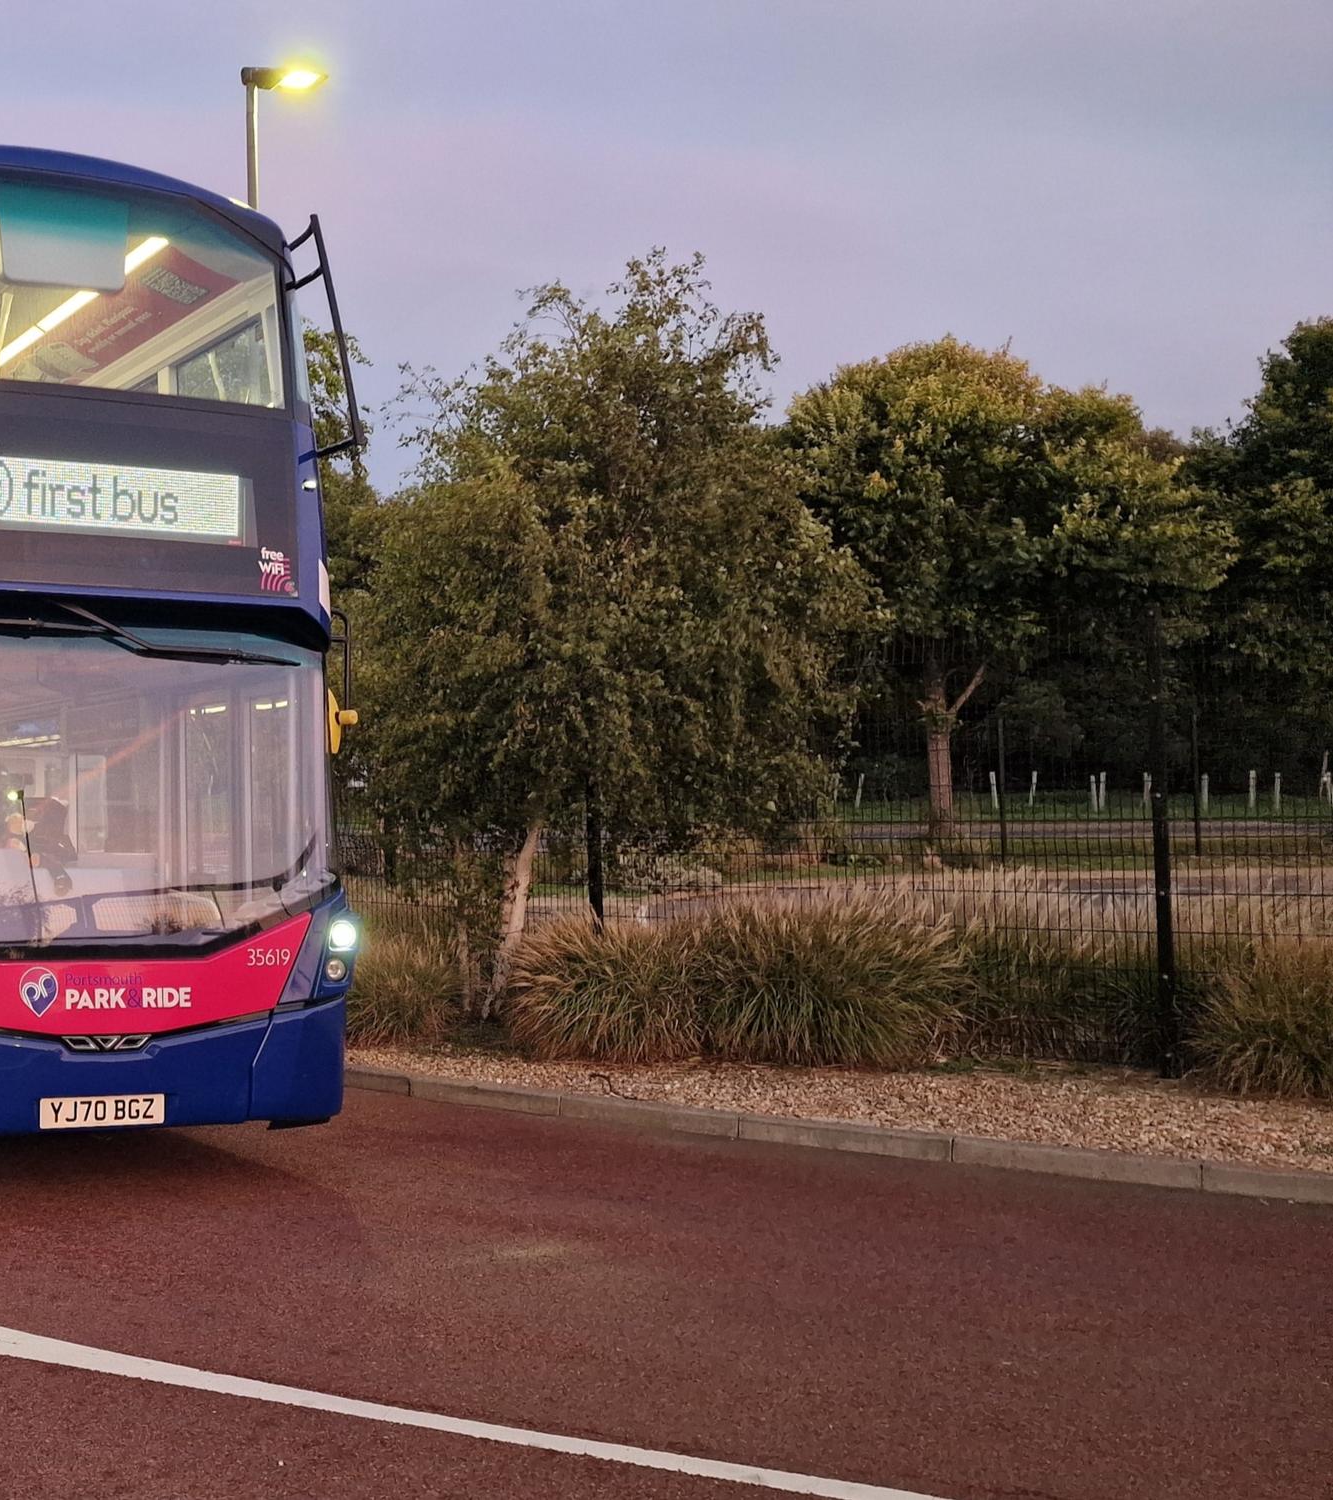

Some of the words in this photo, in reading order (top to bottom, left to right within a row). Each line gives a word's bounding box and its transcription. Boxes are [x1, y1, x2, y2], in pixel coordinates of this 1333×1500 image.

[23, 470, 101, 520] first
[110, 475, 179, 525] bus
[261, 547, 284, 561] free
[258, 561, 285, 576] WiFi
[247, 948, 291, 966] 35619
[65, 972, 142, 987] Portsmouth
[50, 1100, 107, 1123] YJ70
[114, 1098, 154, 1121] BGZ
